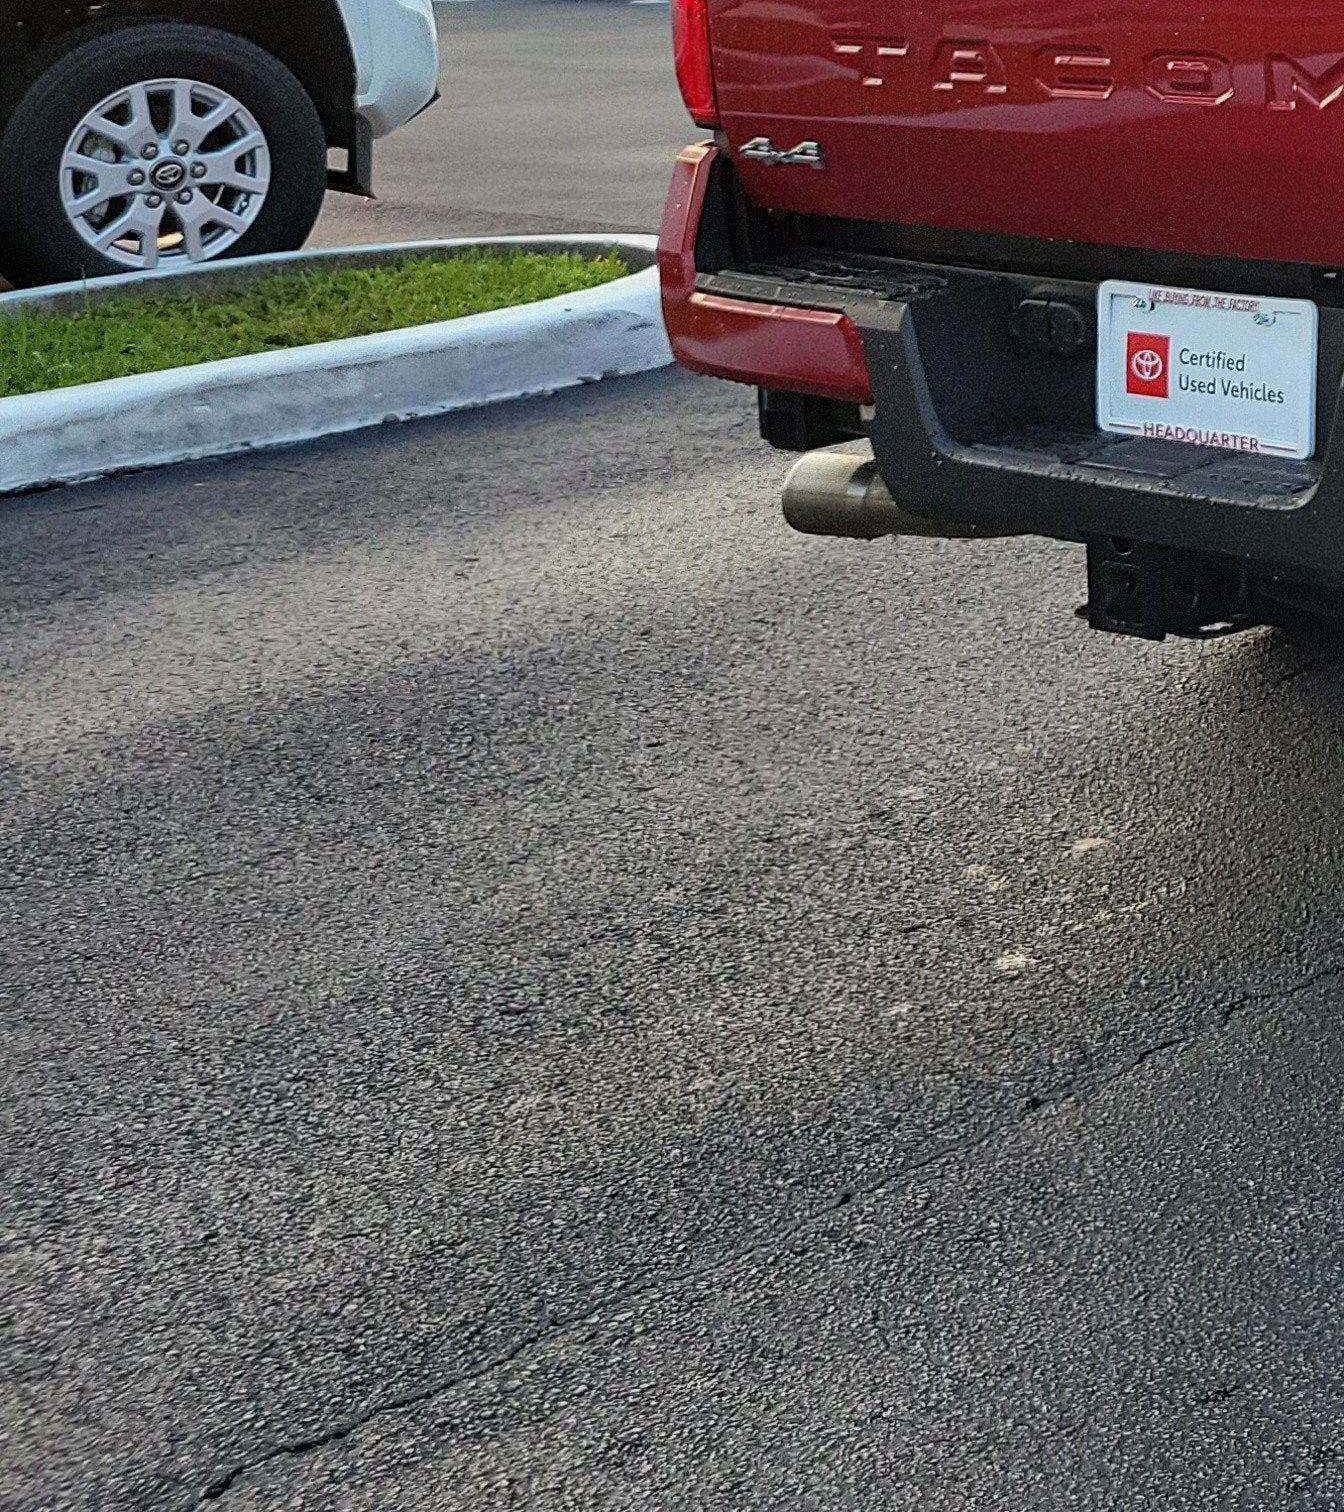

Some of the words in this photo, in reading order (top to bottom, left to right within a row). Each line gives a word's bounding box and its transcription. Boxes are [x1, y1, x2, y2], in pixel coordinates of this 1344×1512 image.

[1191, 293, 1211, 308] FROM
[1211, 296, 1227, 309] THE
[1179, 348, 1245, 372] Certified
[1179, 374, 1216, 396] Used
[1222, 379, 1285, 404] Vehicles
[1143, 422, 1259, 451] HEADQUARTER
